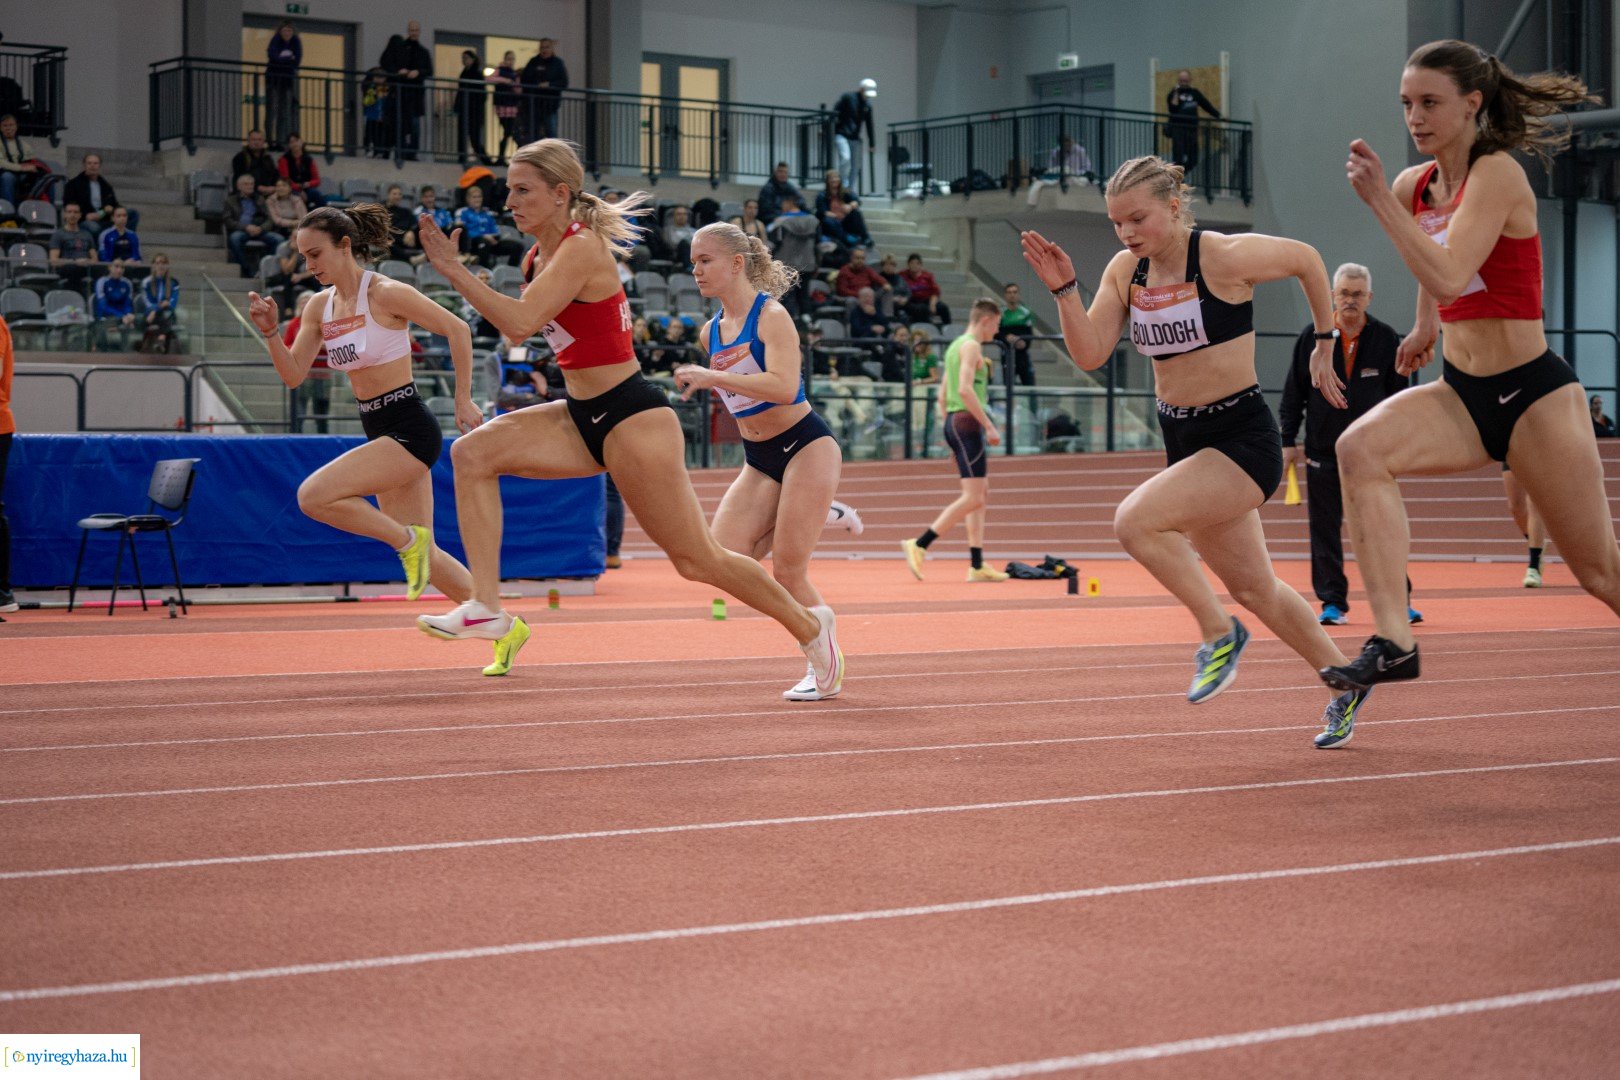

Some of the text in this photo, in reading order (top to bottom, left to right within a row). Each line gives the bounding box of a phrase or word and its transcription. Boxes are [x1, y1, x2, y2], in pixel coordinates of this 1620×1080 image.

[1133, 318, 1199, 346] BOLDOGH
[328, 343, 360, 366] FODOR
[359, 386, 414, 413] NIKE PRO
